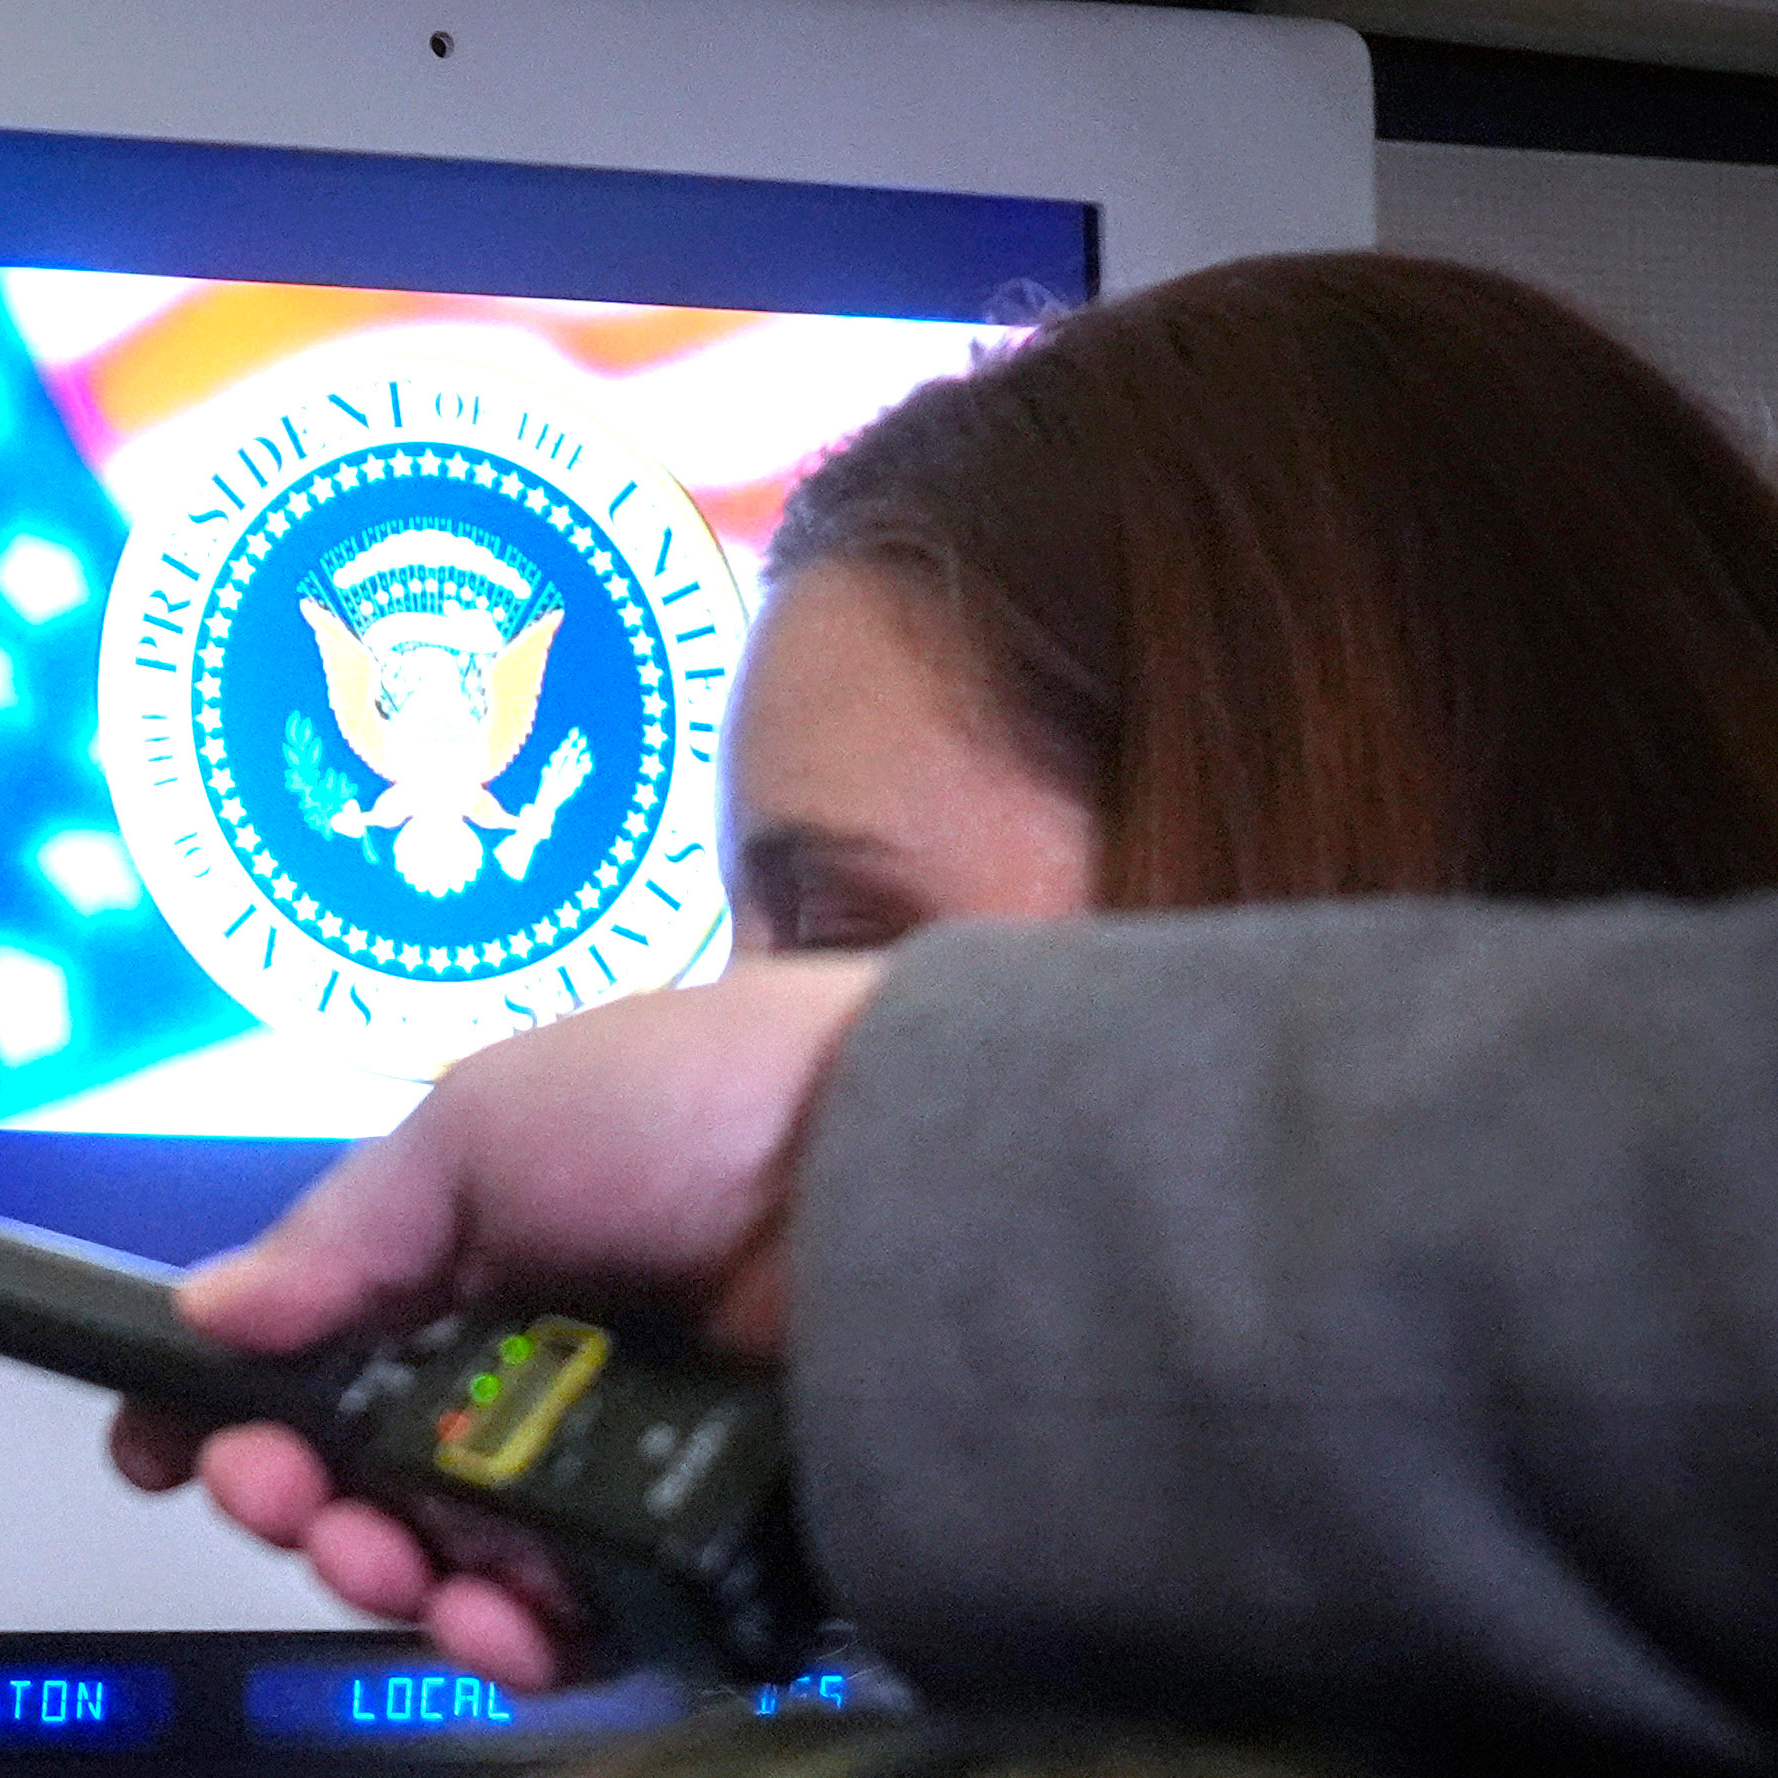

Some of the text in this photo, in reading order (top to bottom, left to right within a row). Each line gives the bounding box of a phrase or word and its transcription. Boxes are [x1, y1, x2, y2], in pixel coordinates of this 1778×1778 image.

[434, 391, 487, 426] OF
[134, 379, 412, 674] PRESIDENT
[606, 479, 726, 765] UNITED
[503, 841, 707, 1036] STATES
[352, 1676, 512, 1722] LOCAL
